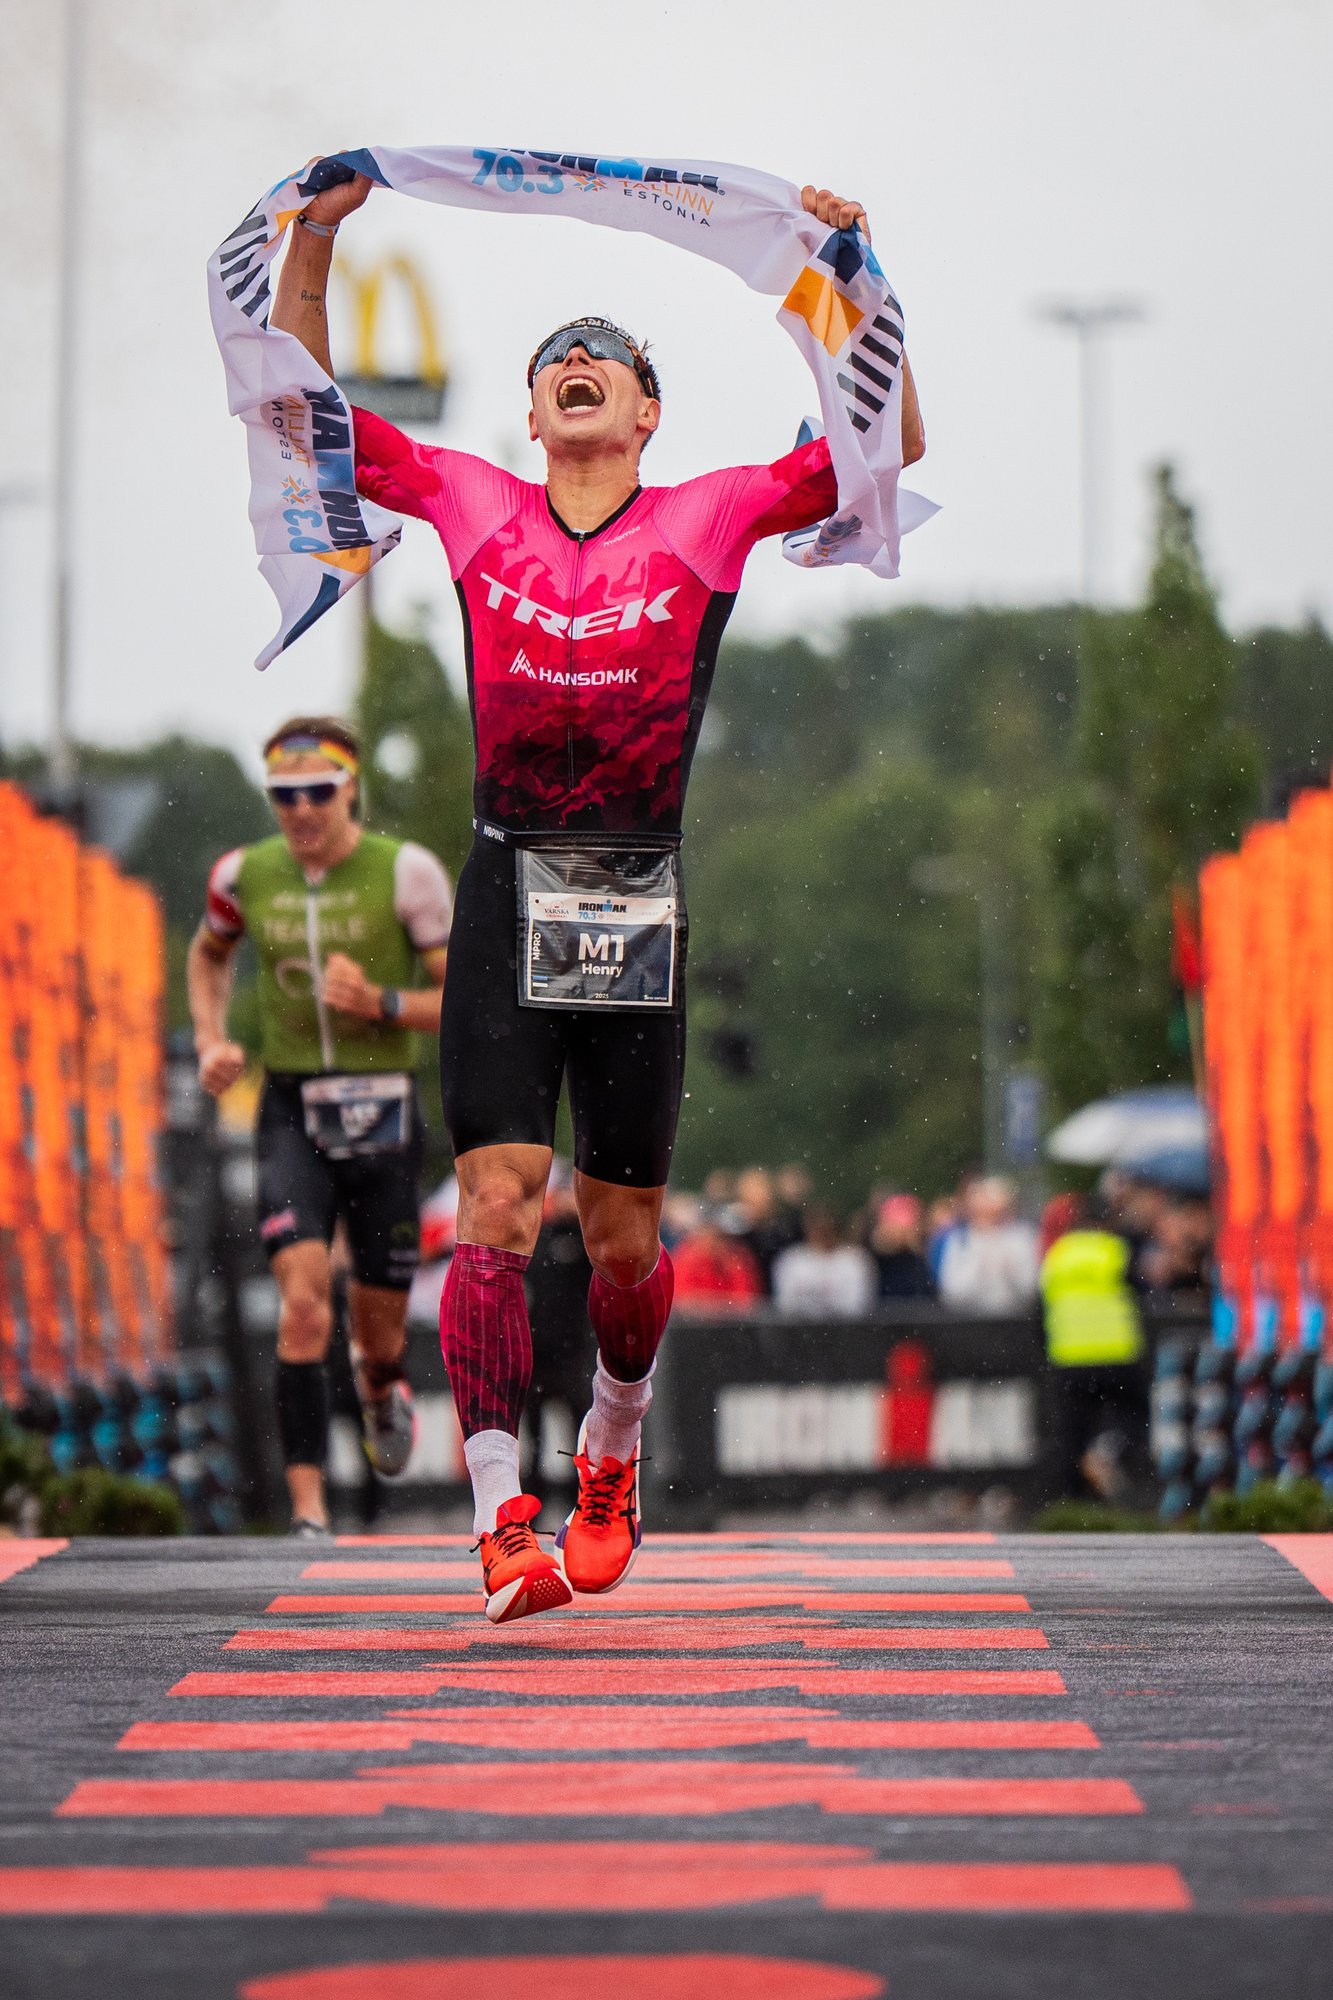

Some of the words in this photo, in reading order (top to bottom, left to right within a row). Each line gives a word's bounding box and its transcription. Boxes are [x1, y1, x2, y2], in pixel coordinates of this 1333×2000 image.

[472, 148, 564, 194] 70.3
[618, 180, 714, 216] TALLINN
[624, 188, 711, 228] ESTONIA
[480, 571, 682, 640] TREK
[539, 667, 639, 686] HANSOMK
[578, 899, 627, 913] IRONMAN
[578, 911, 596, 921] 70.3
[532, 932, 542, 960] MPRO
[578, 932, 624, 962] M1
[582, 963, 623, 978] Henry
